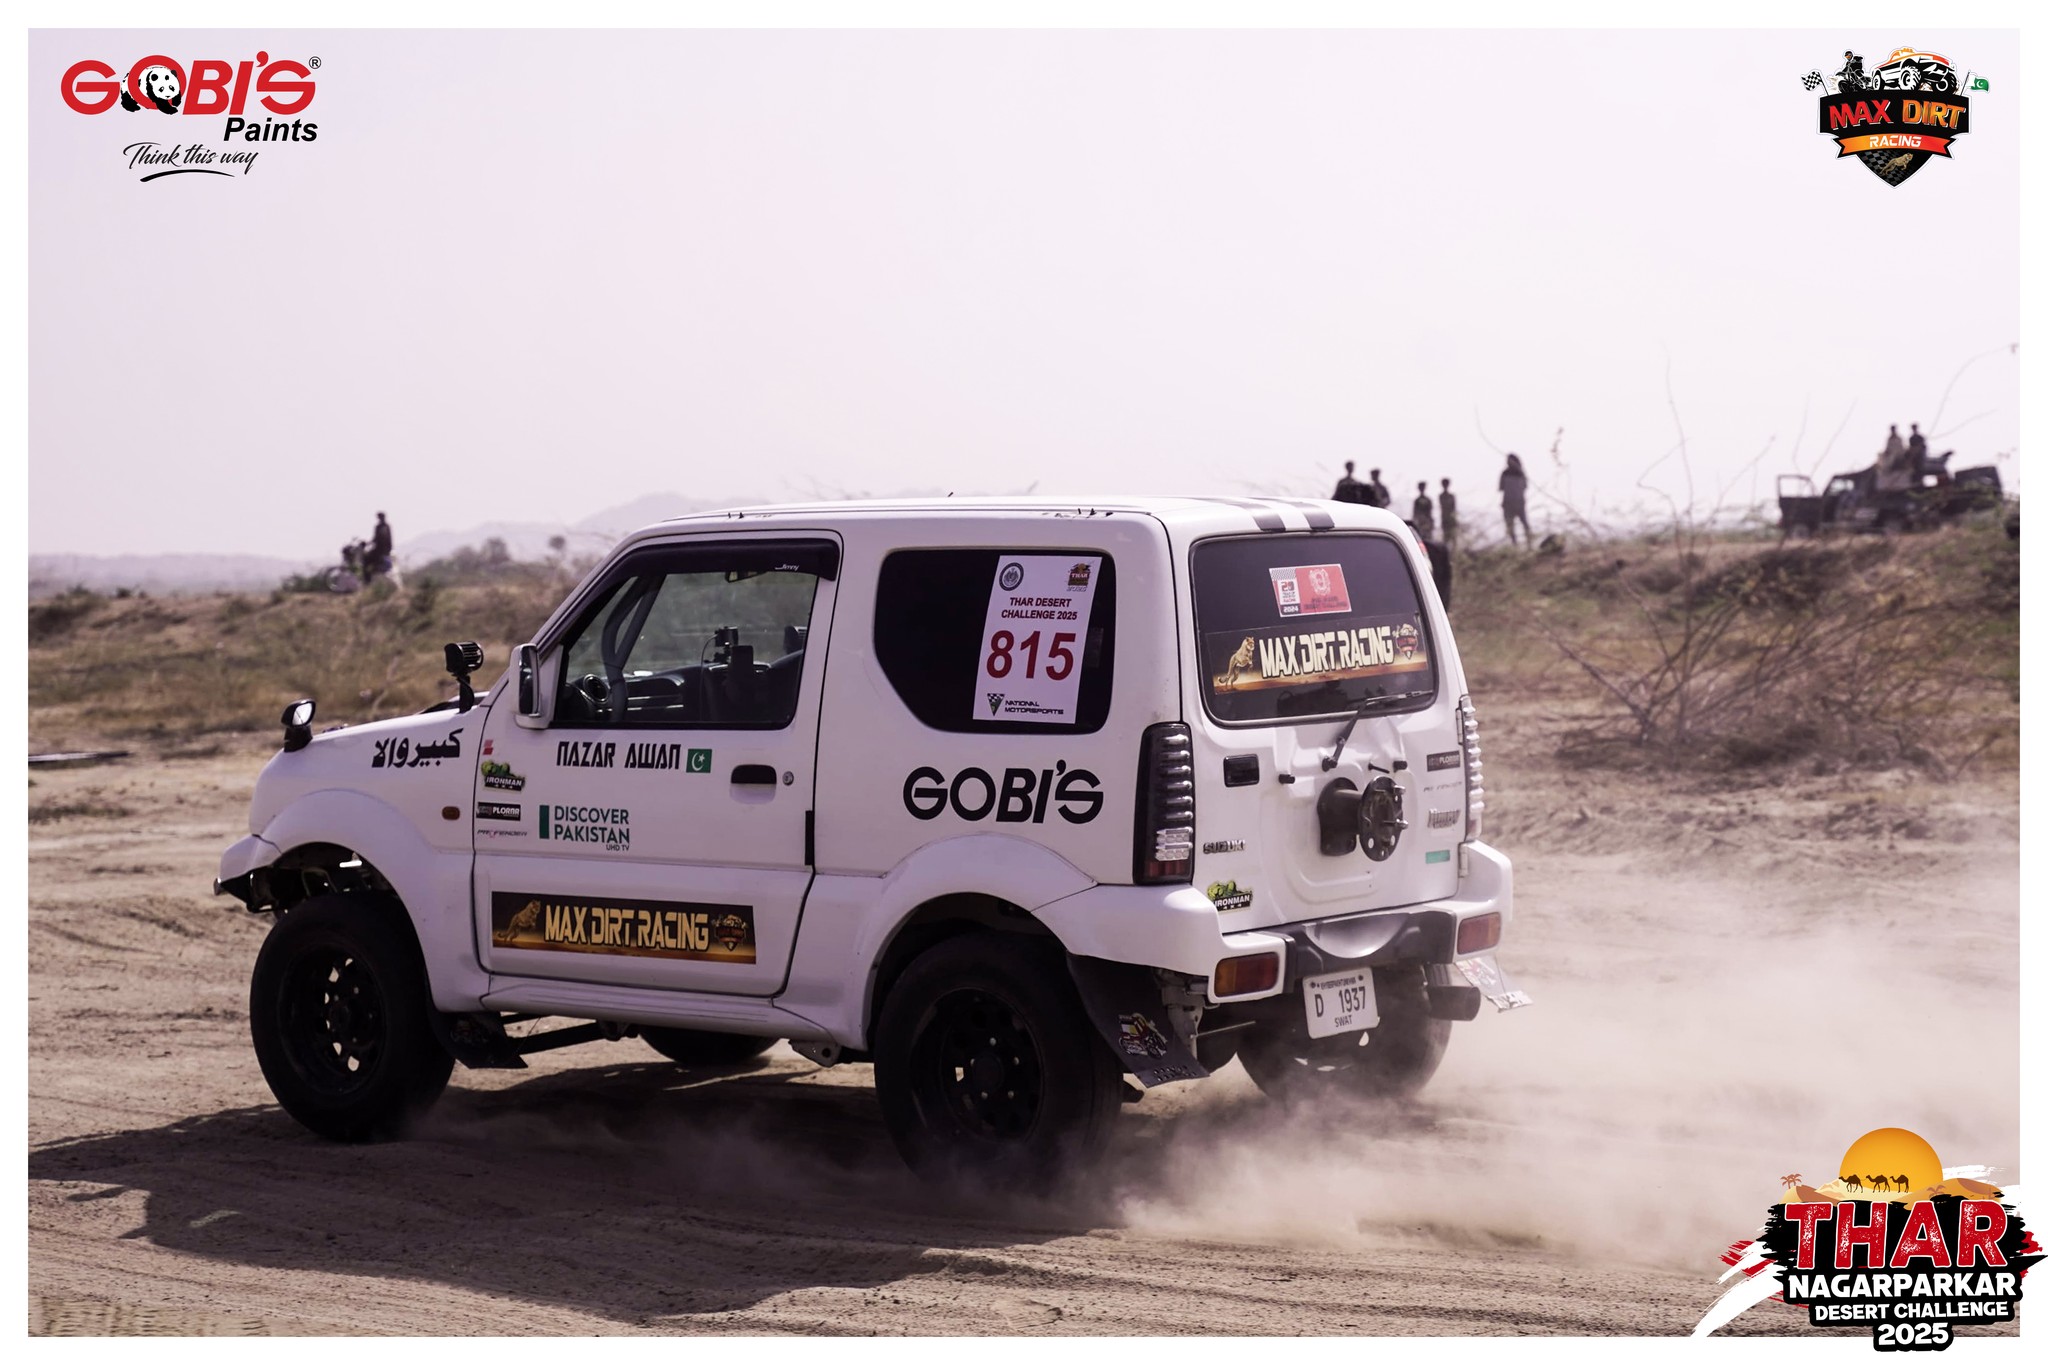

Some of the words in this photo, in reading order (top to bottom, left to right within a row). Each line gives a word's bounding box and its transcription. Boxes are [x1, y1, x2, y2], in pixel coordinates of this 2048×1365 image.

[1010, 597, 1034, 606] THAR
[1035, 598, 1072, 607] DESERT
[1001, 610, 1055, 620] CHALLENGE
[1056, 611, 1078, 620] 2025
[986, 630, 1076, 681] 815
[1259, 635, 1301, 678] MAX
[1301, 631, 1337, 676] DIRT
[1339, 626, 1395, 670] RACING
[1004, 707, 1064, 715] MOTORSPORTS
[556, 741, 616, 768] NAZAR
[624, 743, 681, 769] AWAN
[486, 776, 522, 787] IRONMAN
[903, 759, 1104, 825] GOBI'S
[554, 806, 629, 825] DISCOVER
[554, 824, 630, 844] PAKISTAN
[1215, 895, 1250, 907] IRONMAN
[544, 904, 588, 944] MAX
[590, 907, 635, 947] DIRT
[637, 910, 709, 951] RACING
[1314, 994, 1324, 1018] D
[1339, 986, 1366, 1013] 1937
[1334, 1015, 1352, 1028] SWAT
